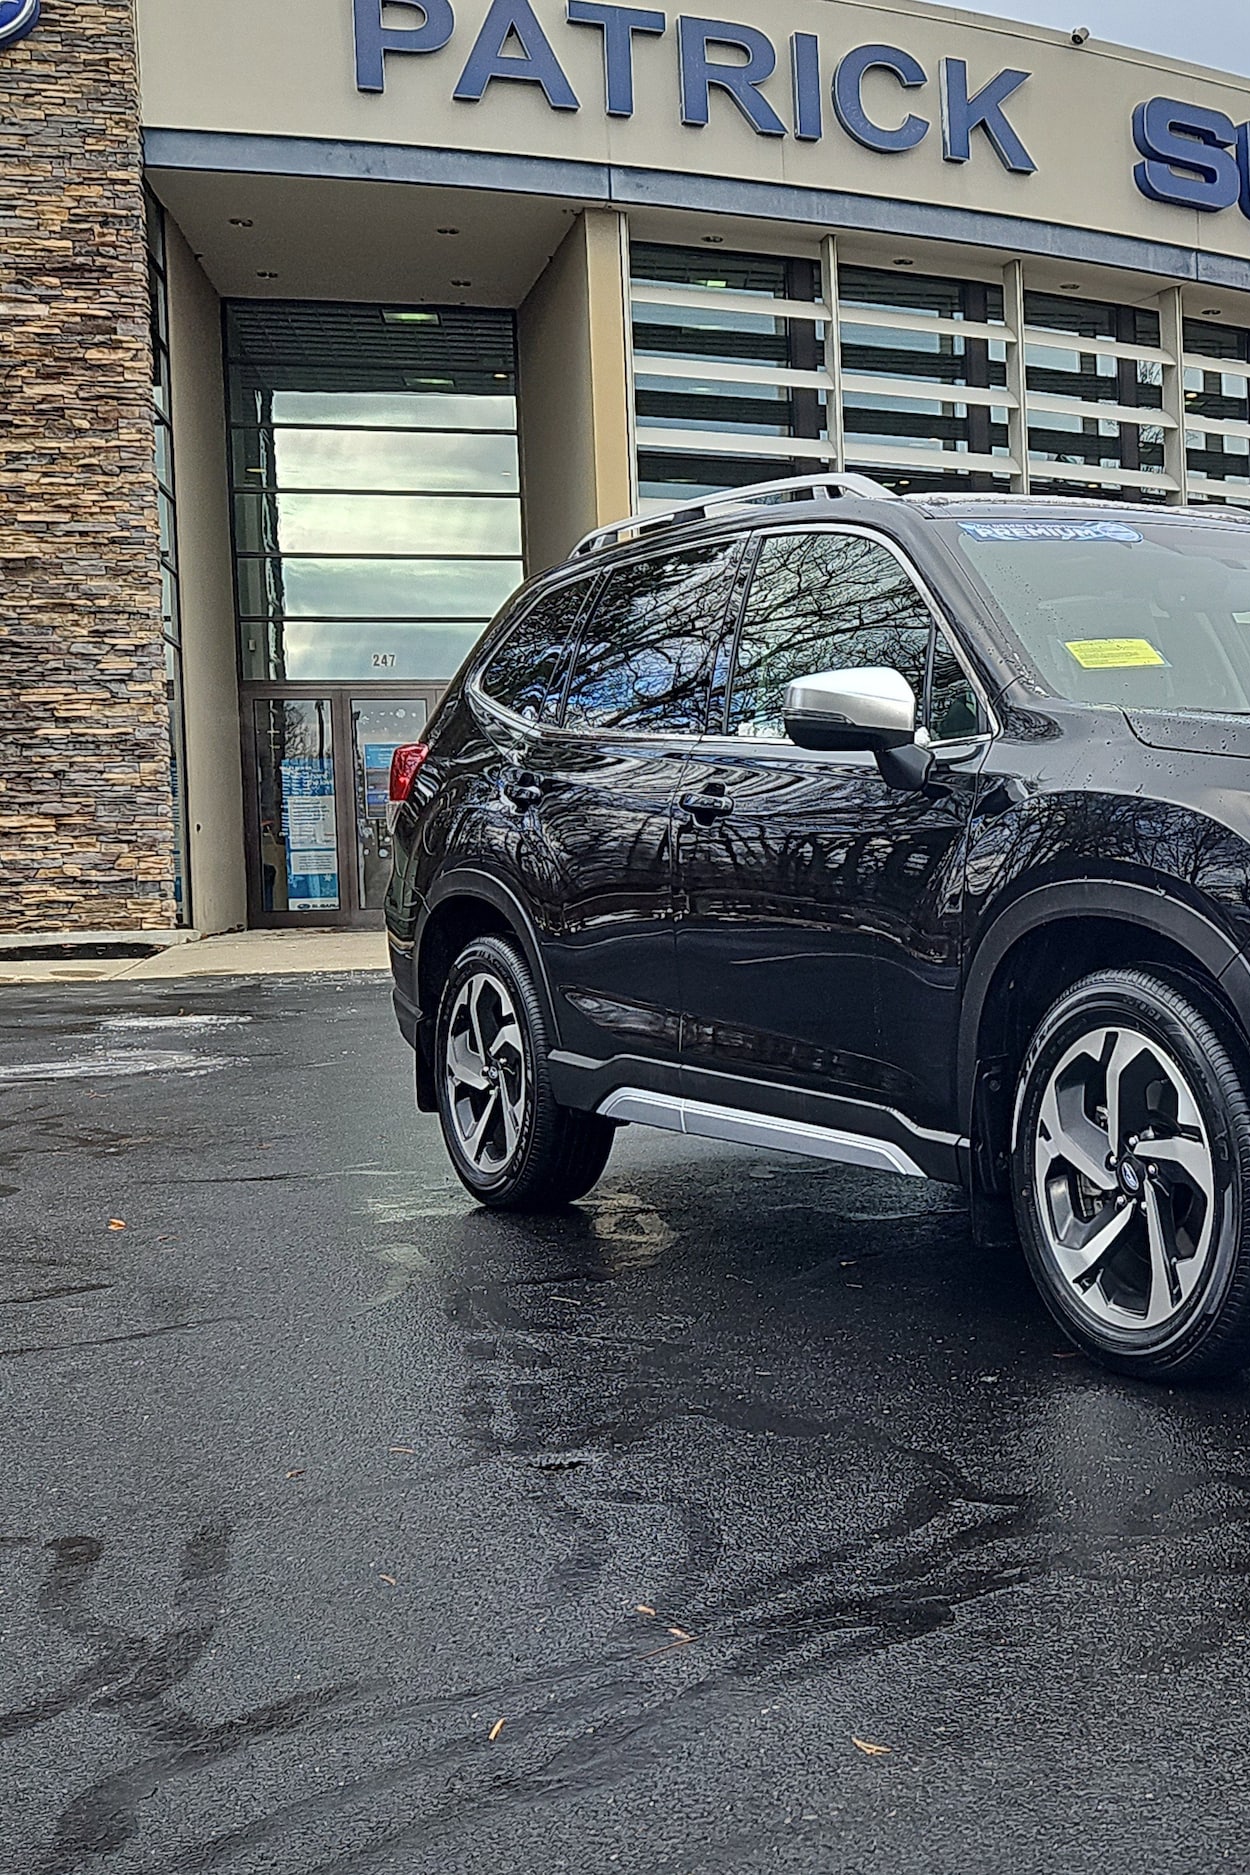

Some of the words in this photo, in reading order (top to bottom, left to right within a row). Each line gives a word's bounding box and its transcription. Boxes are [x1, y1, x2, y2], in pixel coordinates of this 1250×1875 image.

[352, 0, 1039, 174] PATRICK
[976, 527, 1098, 539] PREMIUM
[372, 654, 395, 667] 247
